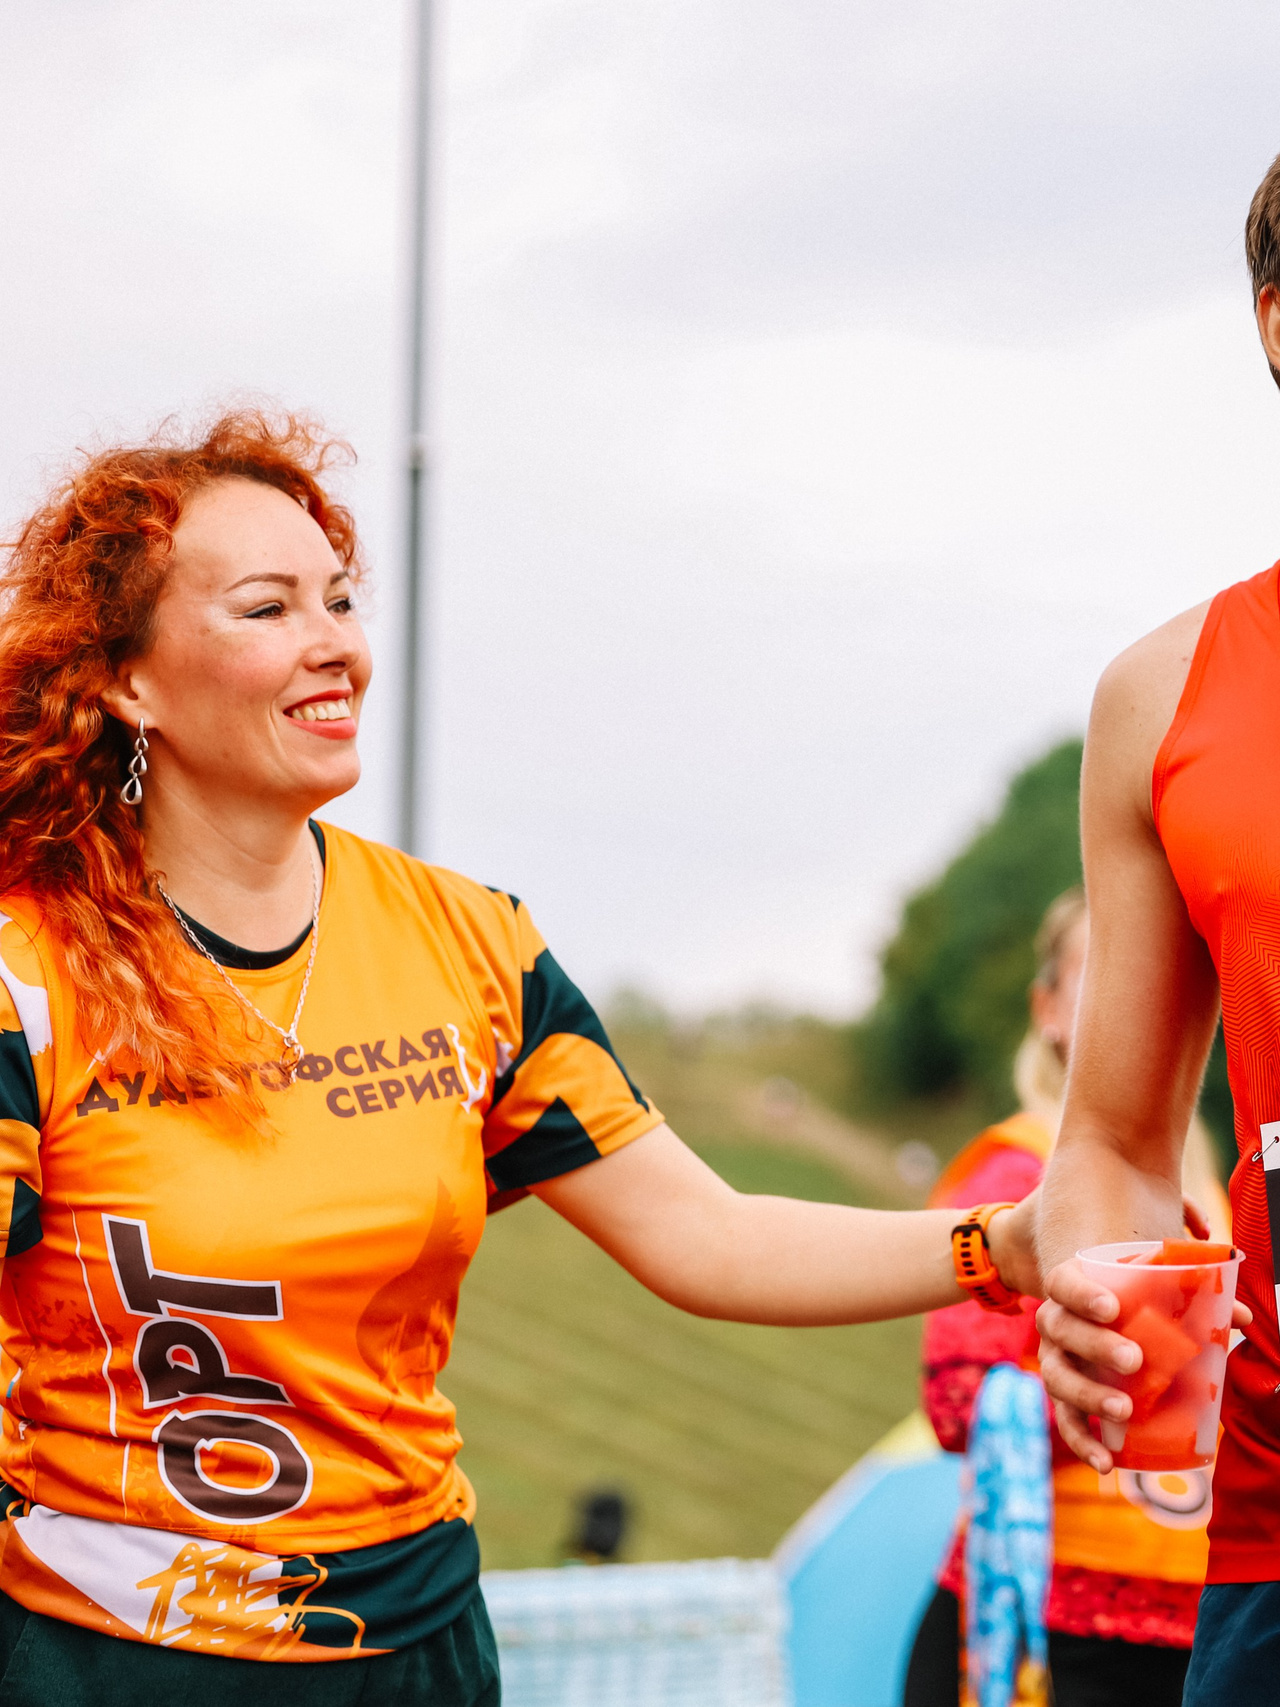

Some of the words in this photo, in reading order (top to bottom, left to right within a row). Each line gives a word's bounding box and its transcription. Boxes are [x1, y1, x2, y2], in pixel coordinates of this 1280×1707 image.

[76, 1027, 452, 1118] ДУДОФСКАЯ
[326, 1065, 466, 1119] СЕРИЯ
[101, 1213, 313, 1525] ОРТ
